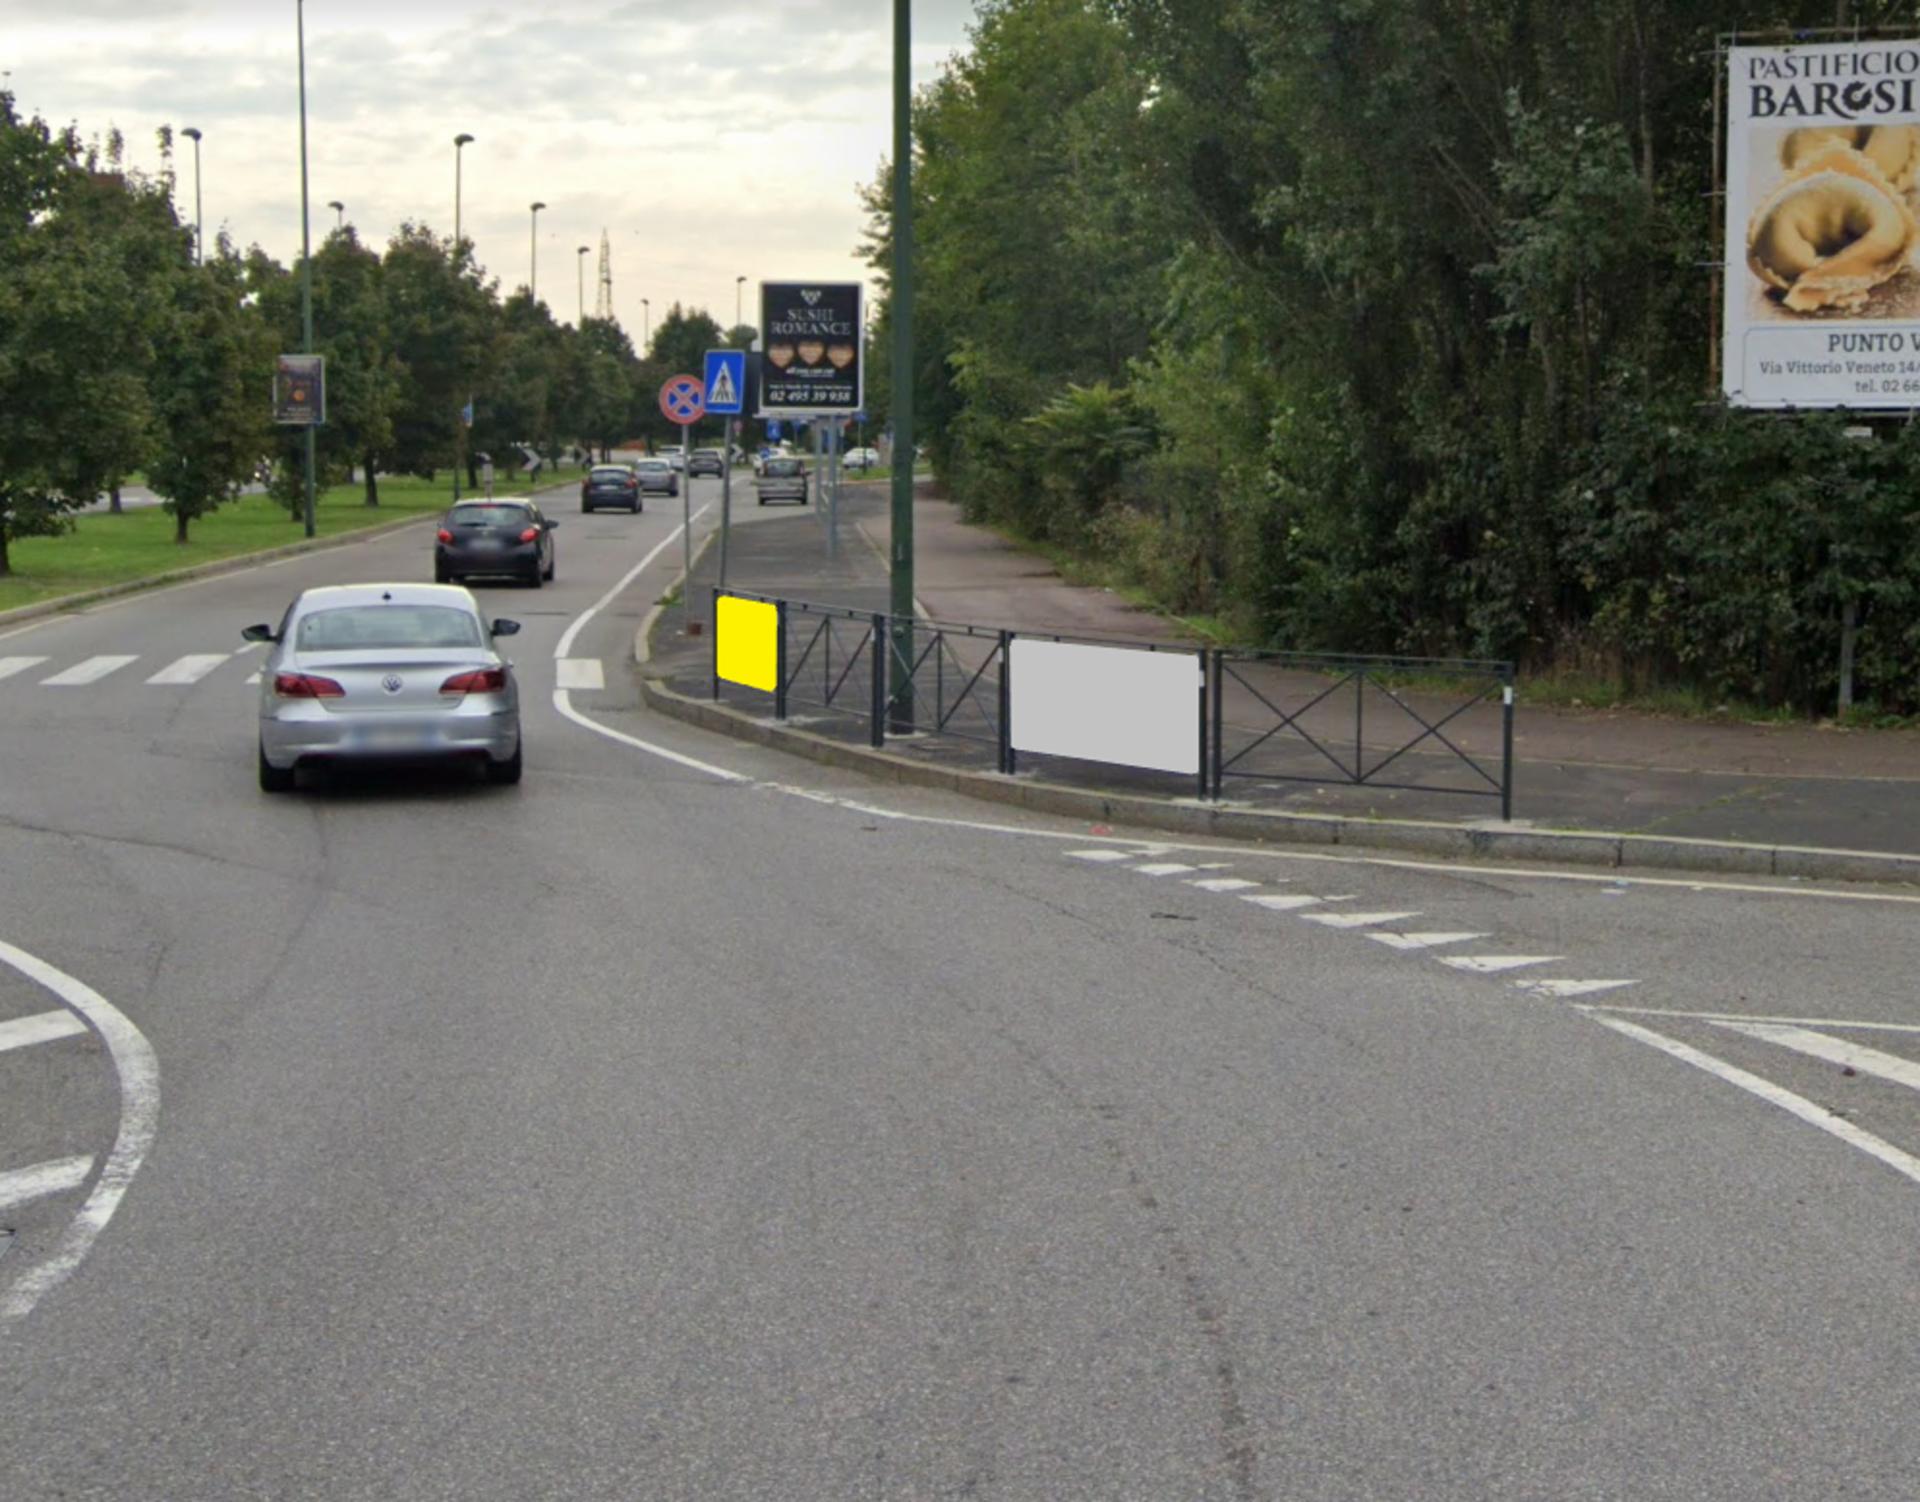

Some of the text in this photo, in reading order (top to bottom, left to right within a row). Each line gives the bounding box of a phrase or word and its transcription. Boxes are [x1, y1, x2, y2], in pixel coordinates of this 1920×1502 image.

[1749, 50, 1920, 79] PASTIFICIO
[1749, 78, 1916, 120] BAROSI
[771, 322, 851, 335] ROMANCE
[1828, 333, 1904, 352] PUNTO
[1760, 361, 1783, 374] Via
[1786, 360, 1842, 374] Vittorio
[1845, 361, 1895, 374] Veneto
[1855, 380, 1878, 393] tel.
[1881, 380, 1900, 393] 02
[769, 390, 786, 401] 02
